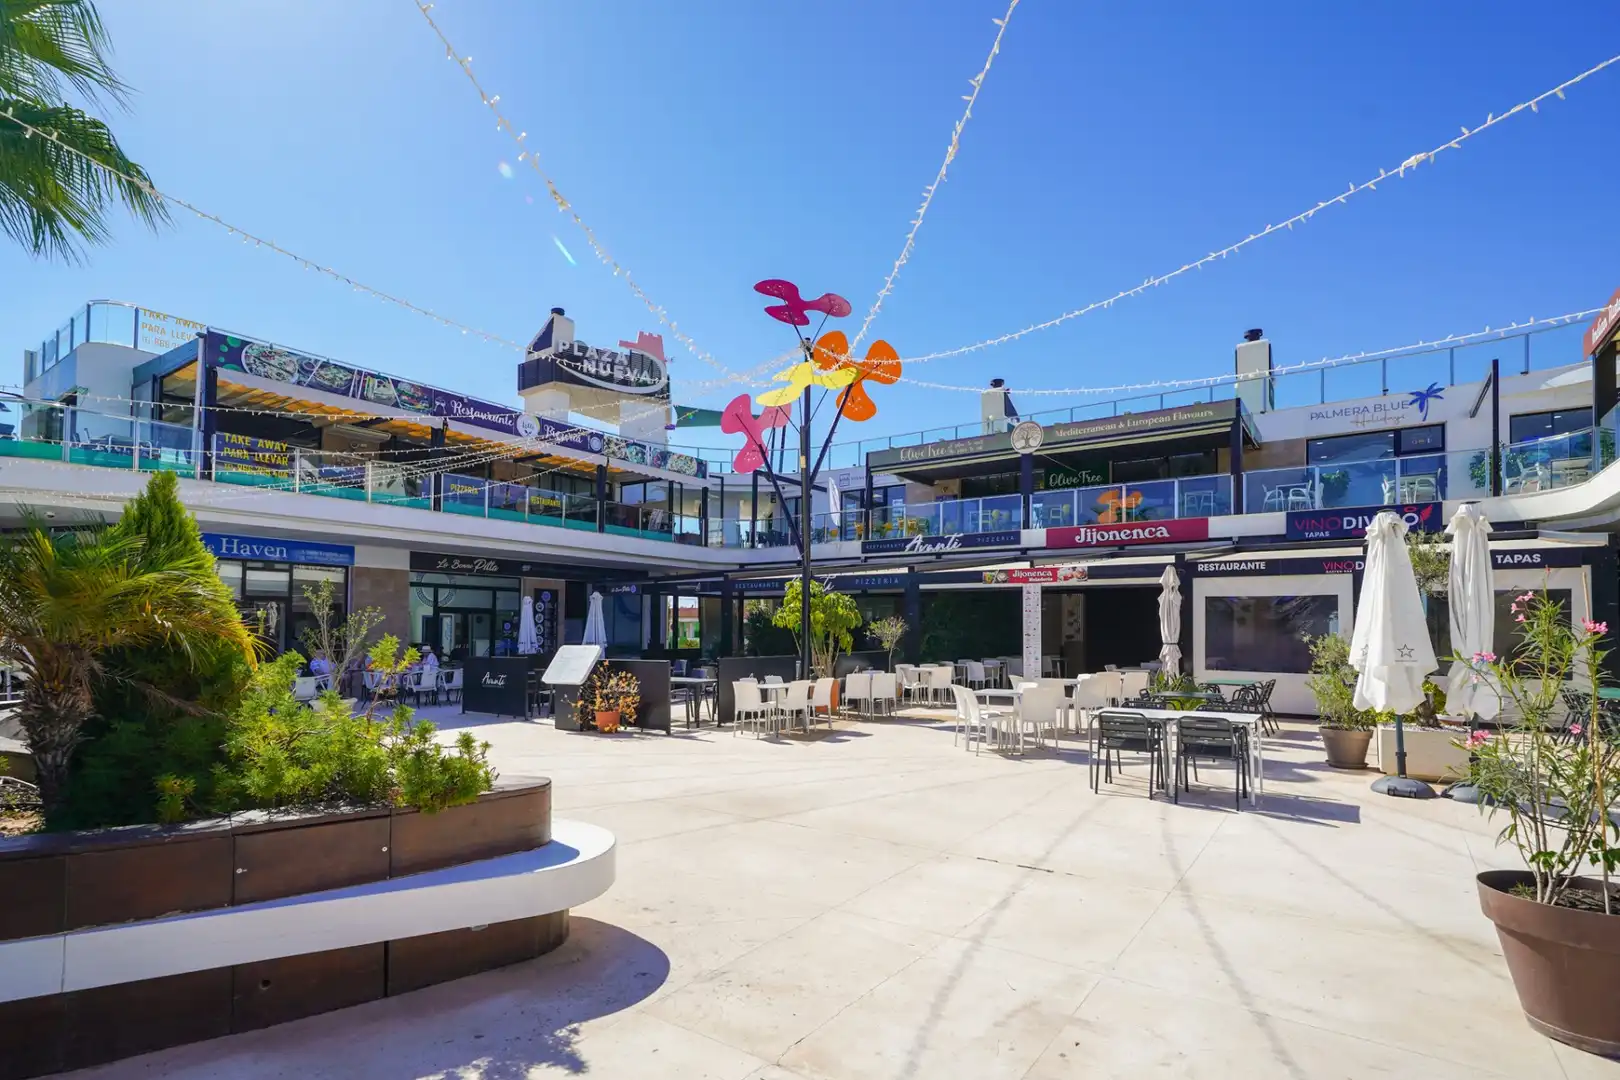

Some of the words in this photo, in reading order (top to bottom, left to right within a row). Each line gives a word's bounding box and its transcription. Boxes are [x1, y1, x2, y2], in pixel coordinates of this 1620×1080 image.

[141, 322, 166, 336] PARA
[171, 329, 197, 342] LLEV
[557, 339, 628, 365] PLAZA
[583, 359, 650, 381] NUEVA
[450, 399, 514, 427] Restaurante
[1310, 405, 1370, 420] PALMERA
[1374, 400, 1409, 413] BLUE
[1055, 422, 1116, 438] Mediterranean
[1118, 421, 1126, 429] &
[1127, 416, 1171, 428] European
[1173, 409, 1214, 421] Flavours
[224, 432, 251, 446] TAKE
[258, 439, 287, 452] AWAY
[224, 447, 249, 460] PARA
[254, 452, 288, 466] LLEVAR
[1074, 526, 1170, 544] Jijonenca
[220, 537, 288, 558] Haven
[1198, 561, 1266, 571] RESTAURANTE
[1496, 553, 1541, 564] TAPAS
[1013, 569, 1052, 579] Jijonenca
